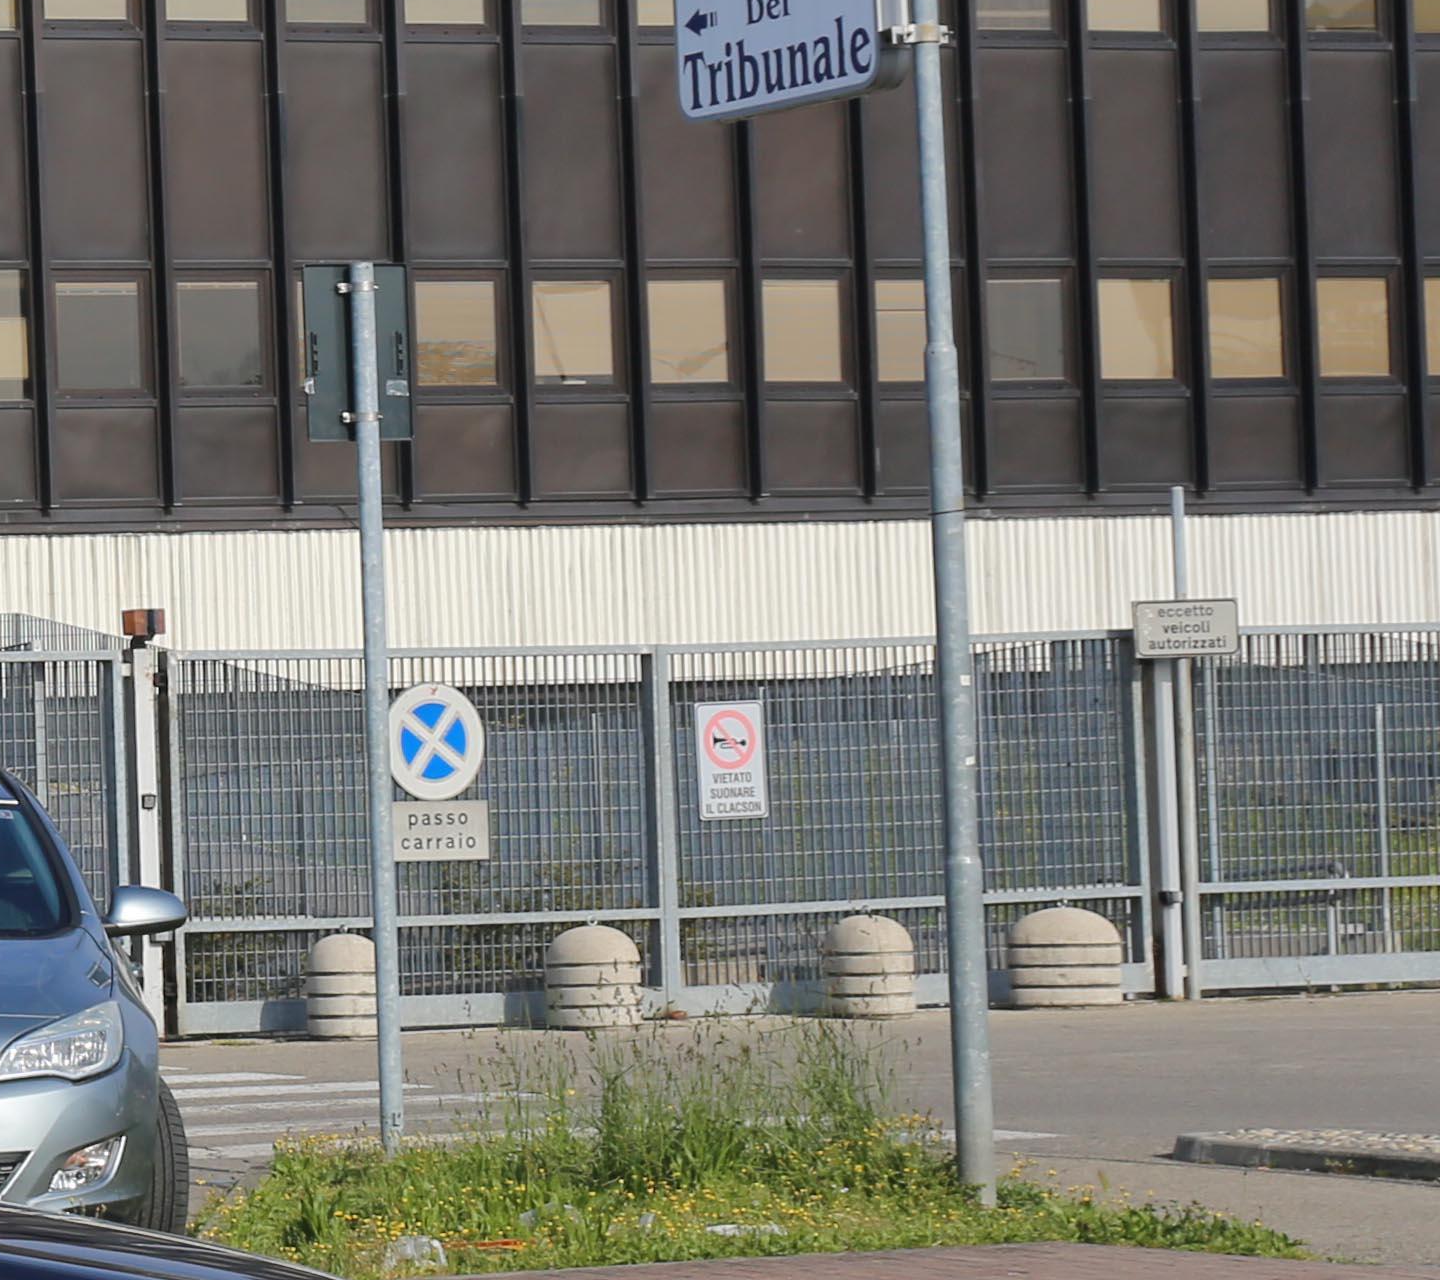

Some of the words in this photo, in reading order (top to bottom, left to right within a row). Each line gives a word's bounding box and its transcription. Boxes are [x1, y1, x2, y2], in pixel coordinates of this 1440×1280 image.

[683, 16, 873, 111] Tribunale
[1157, 605, 1214, 617] eccetto
[1162, 621, 1210, 634] veicoli
[1148, 636, 1227, 650] autorizzati
[712, 772, 752, 784] VIETATO
[710, 786, 755, 800] SUONARE
[706, 804, 714, 814] IL
[717, 801, 762, 814] CLACSON
[408, 812, 468, 830] passo
[401, 833, 476, 850] carraio
